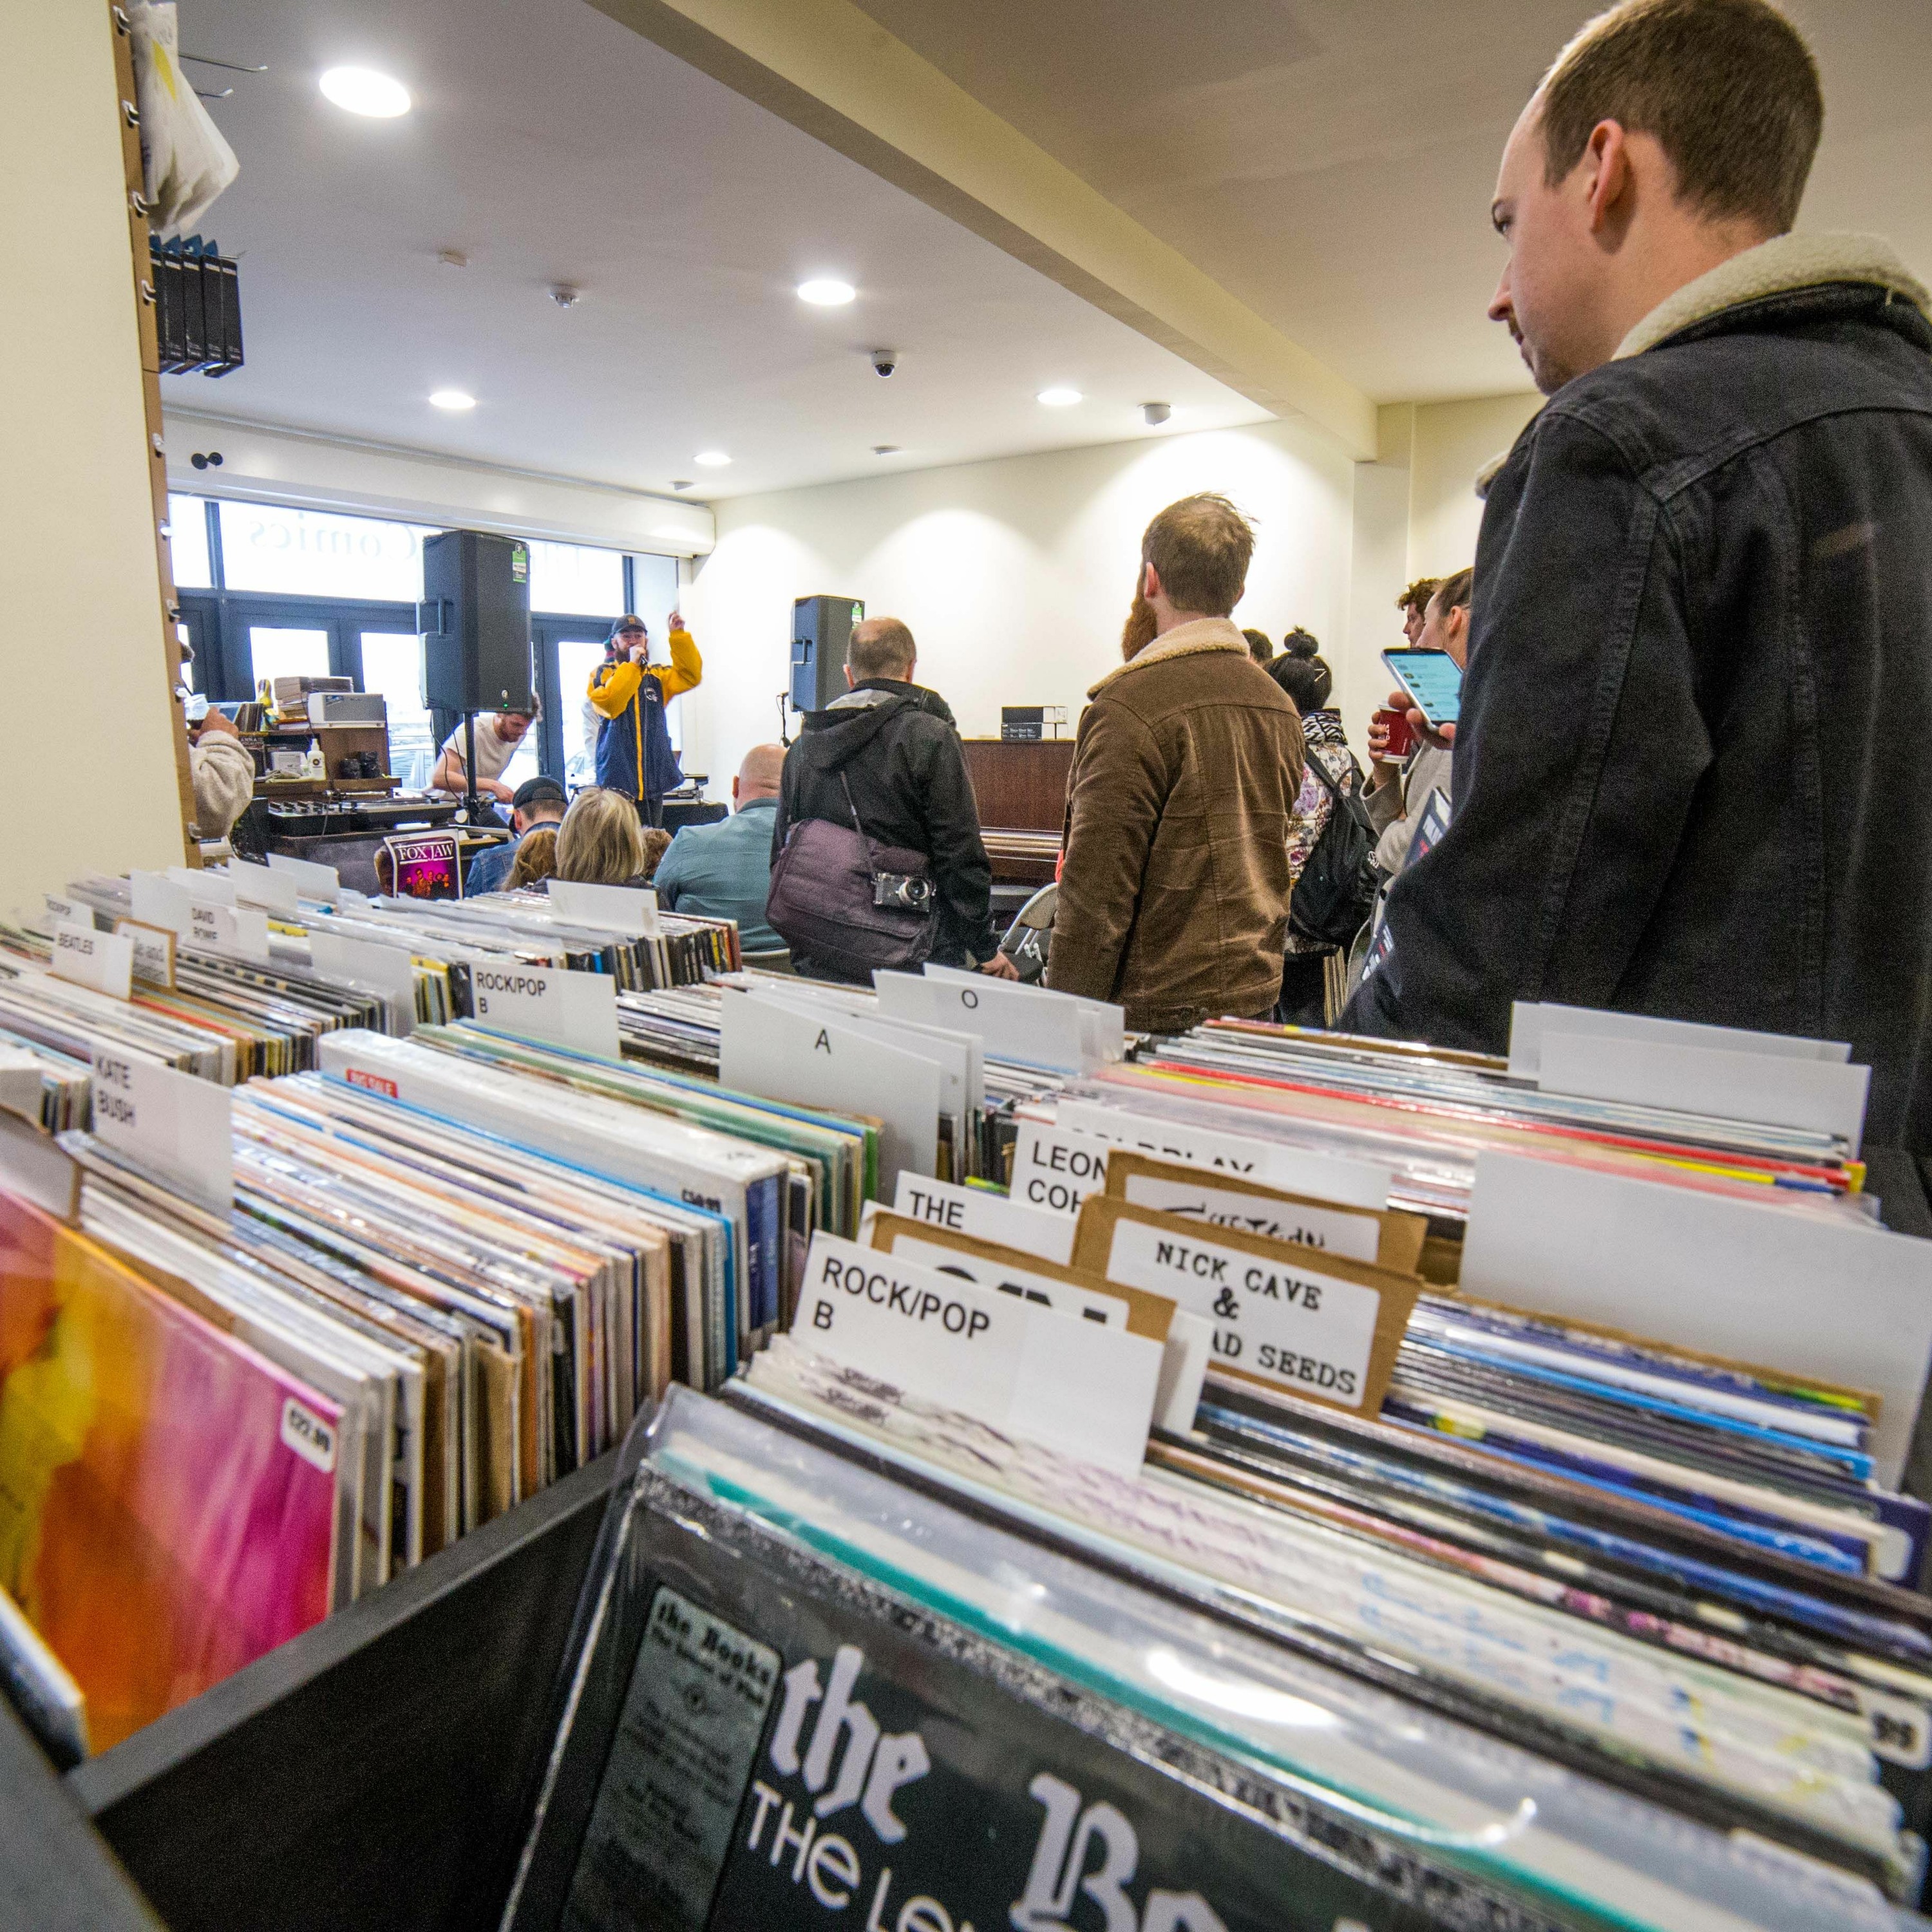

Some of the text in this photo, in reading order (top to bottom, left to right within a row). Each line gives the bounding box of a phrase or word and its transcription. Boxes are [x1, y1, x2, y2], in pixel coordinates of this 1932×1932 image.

[399, 844, 453, 860] FOX JAW
[59, 933, 93, 954] BEATLES
[476, 971, 547, 996] ROCK/POP
[961, 989, 978, 1009] O
[478, 997, 488, 1013] B
[815, 1028, 831, 1055] A
[96, 1056, 131, 1091] KATE
[98, 1090, 136, 1128] BUSH
[908, 1190, 966, 1230] THE
[1155, 1240, 1323, 1311] NICK CAVE
[821, 1255, 992, 1341] ROCK/POP
[1213, 1285, 1240, 1320] &
[813, 1301, 836, 1331] B
[1257, 1341, 1357, 1396] SEEDS
[770, 1643, 932, 1845] the
